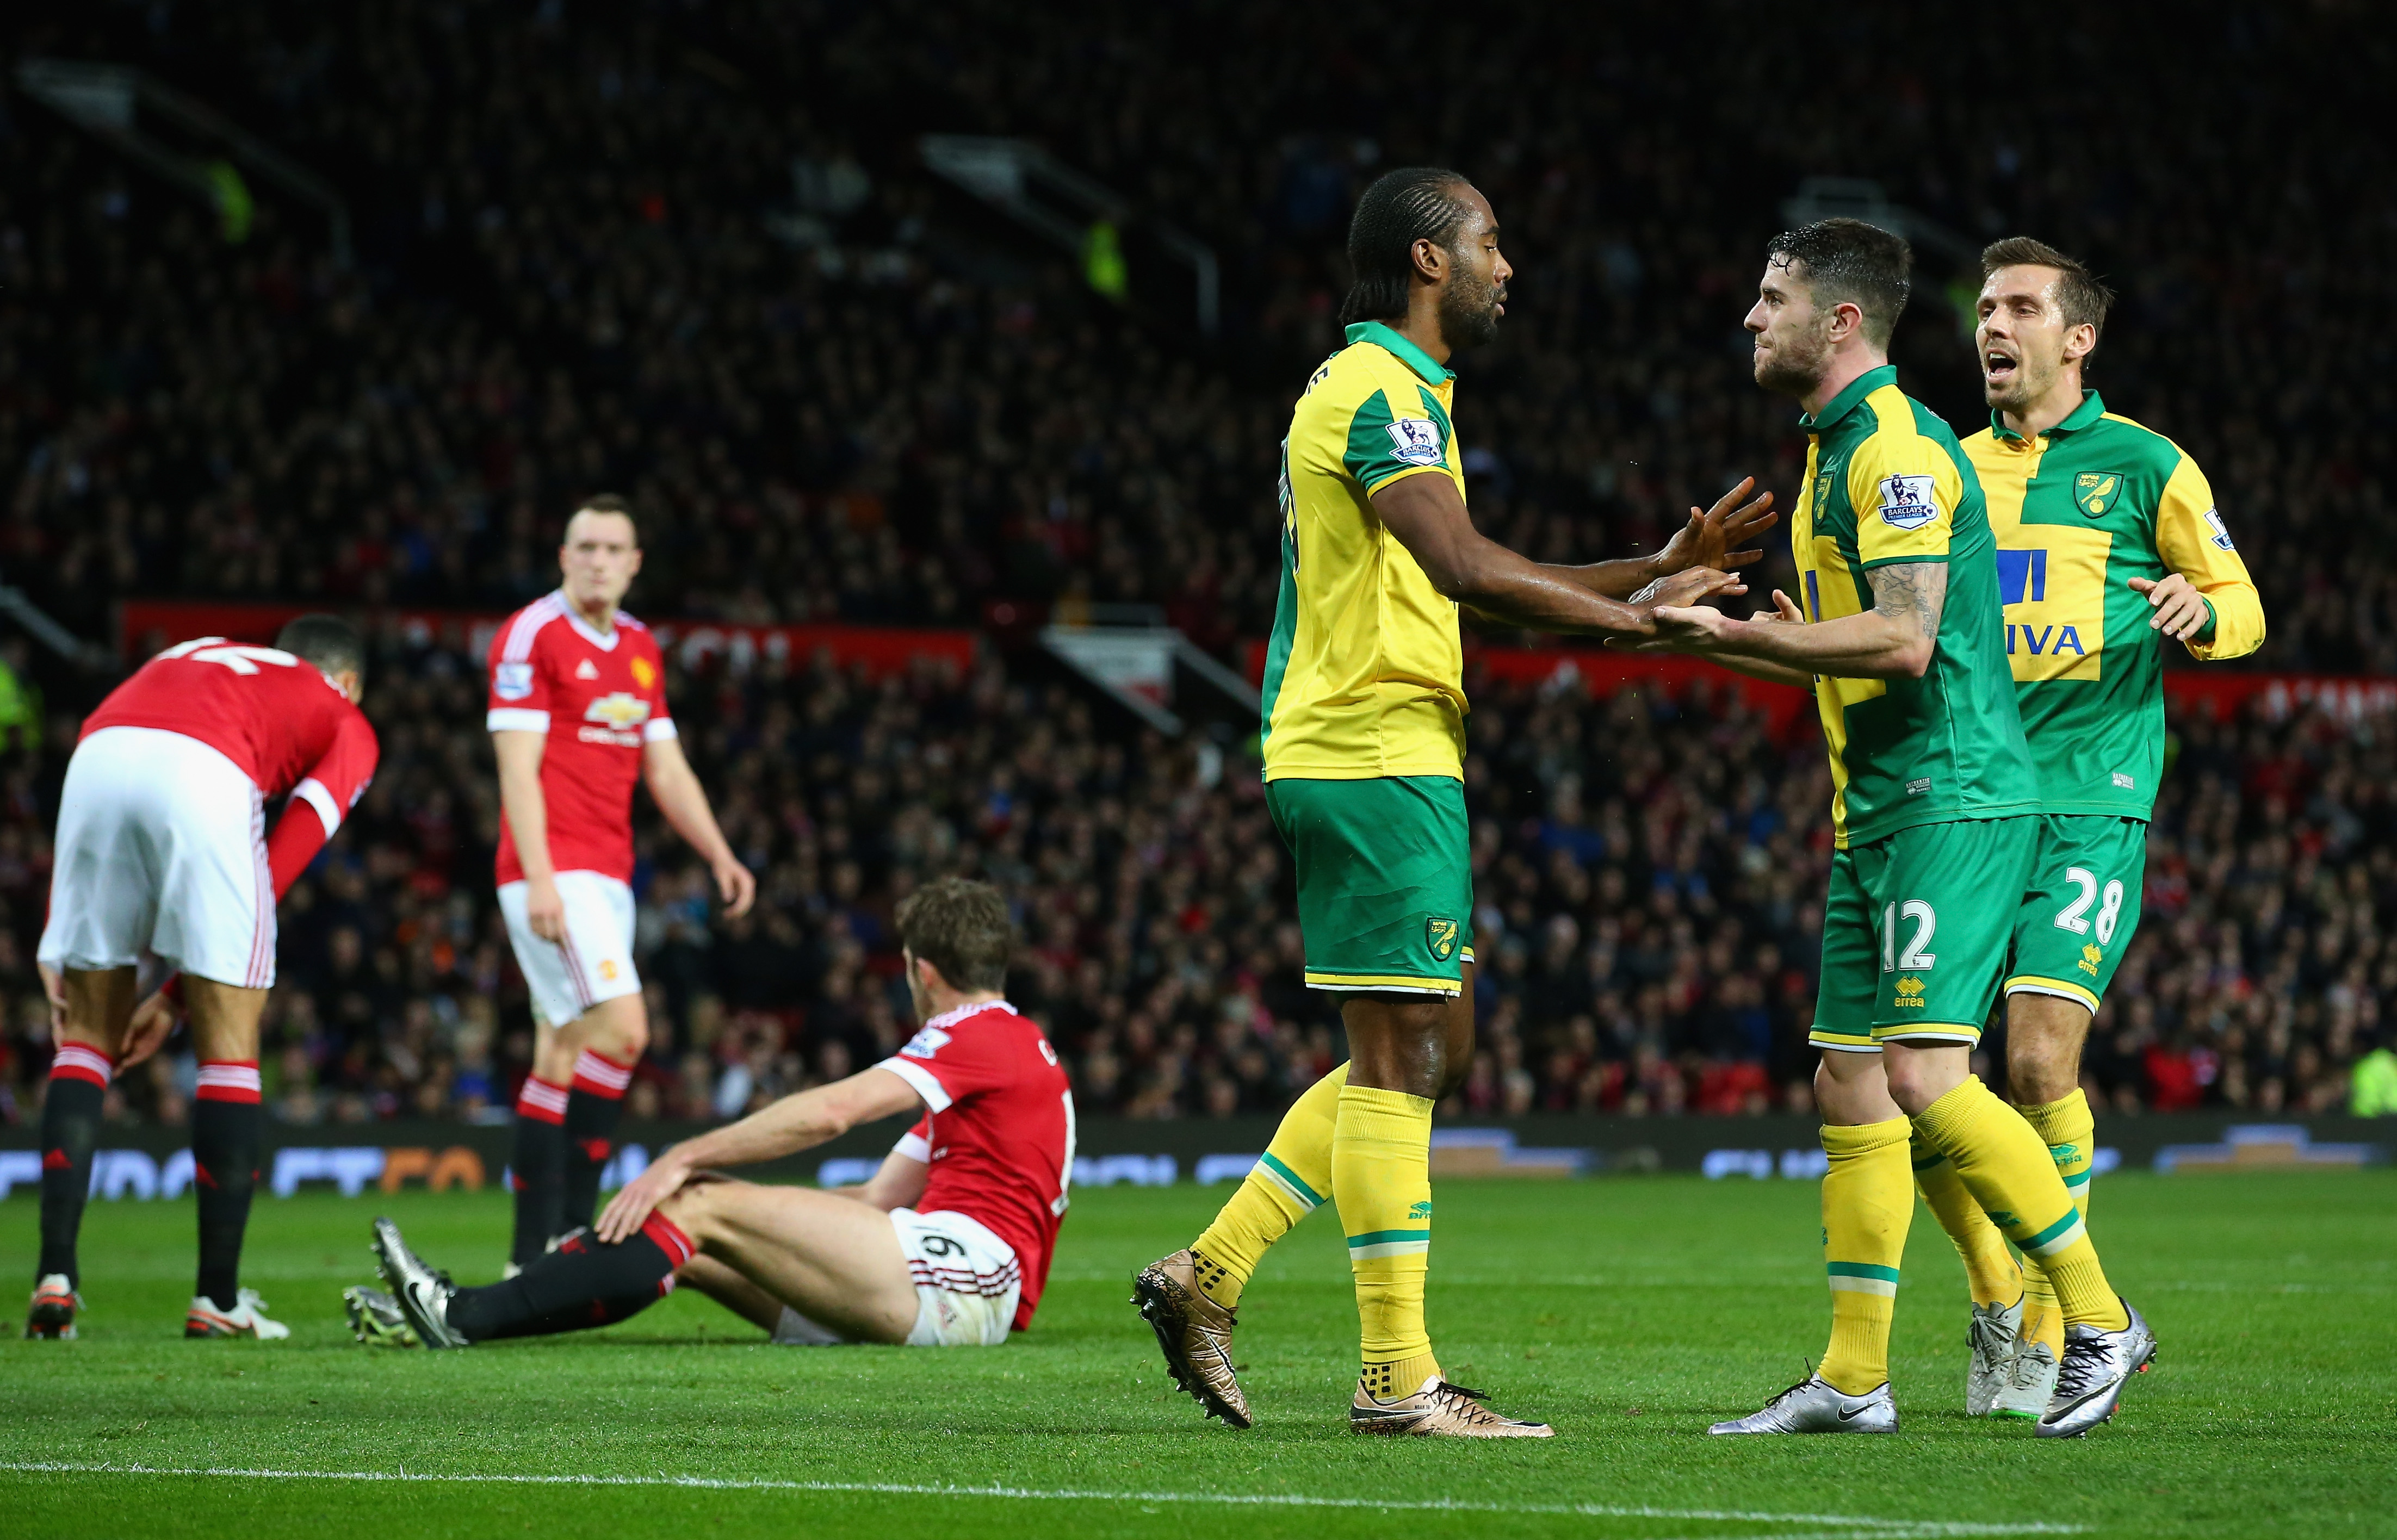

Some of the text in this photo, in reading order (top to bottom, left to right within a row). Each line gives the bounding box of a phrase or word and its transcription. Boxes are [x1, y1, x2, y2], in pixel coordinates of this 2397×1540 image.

[1403, 445, 1430, 454] BARCLAYS
[1888, 506, 1923, 516] BARCLAYS
[2006, 625, 2085, 655] IVA
[2054, 867, 2125, 946] 28
[1884, 899, 1936, 972] 12
[2078, 959, 2098, 977] errea
[1894, 997, 1924, 1007] errea
